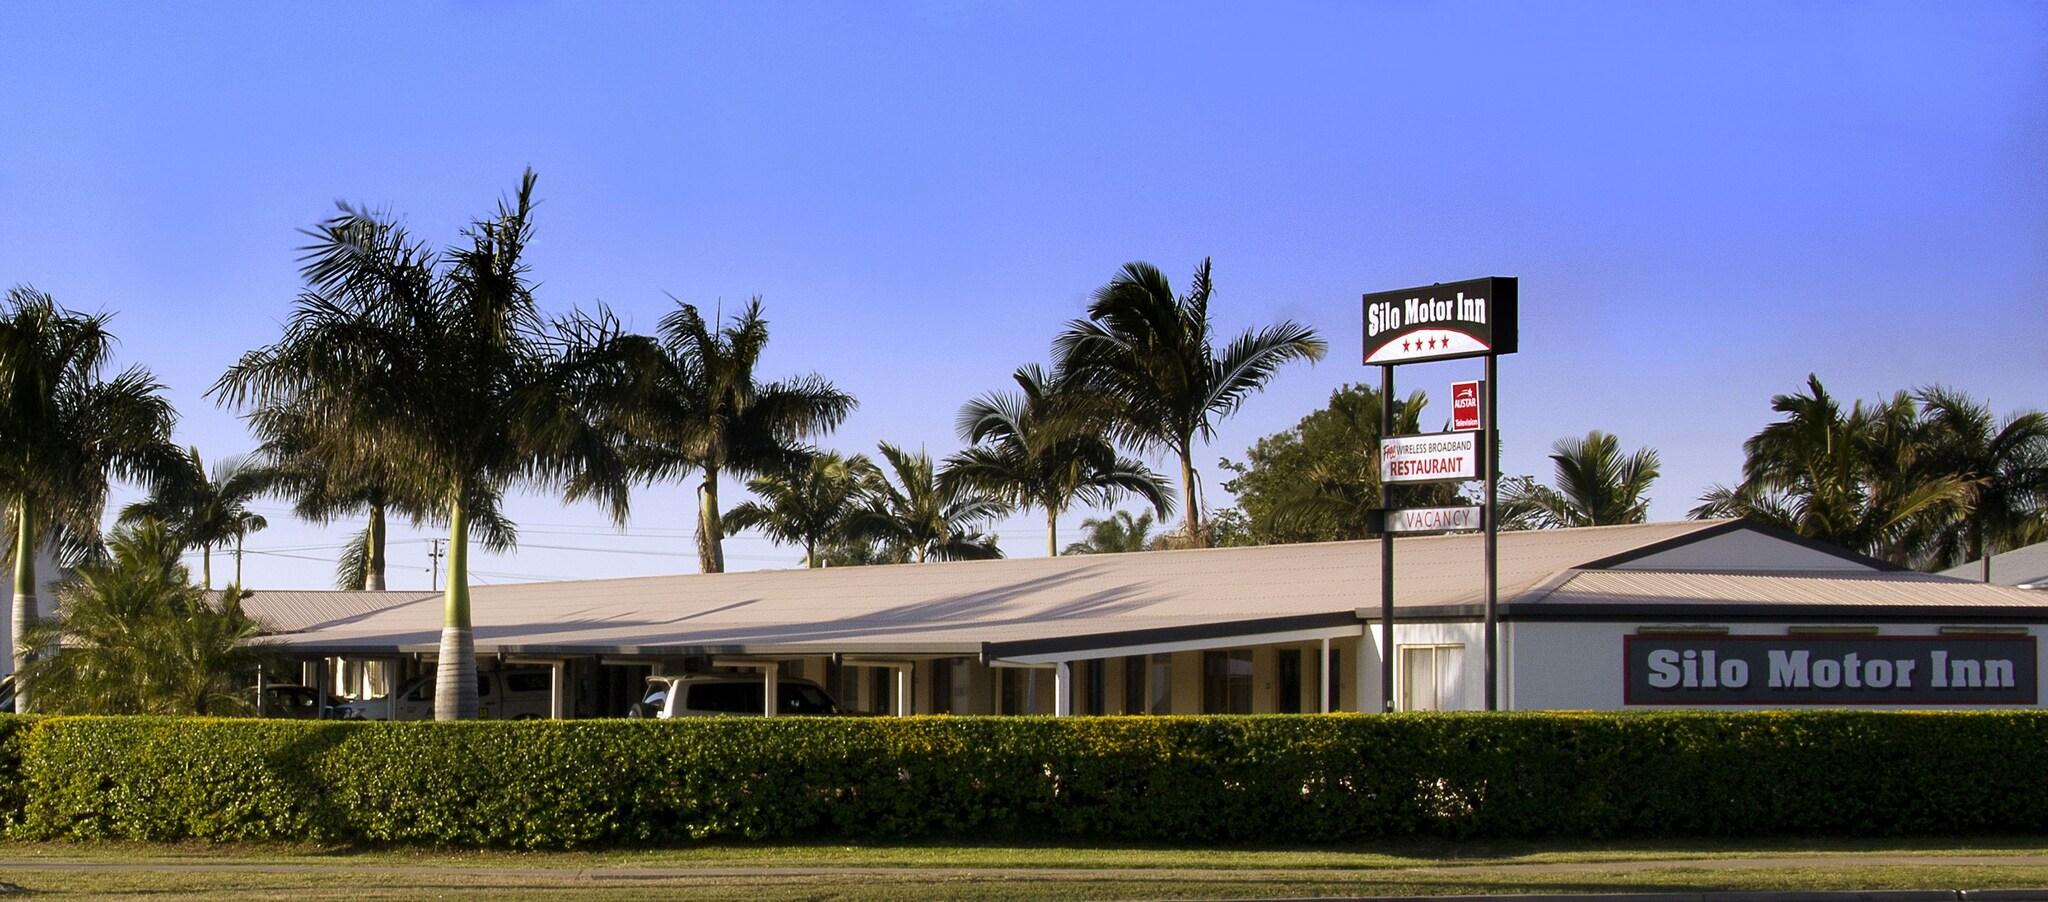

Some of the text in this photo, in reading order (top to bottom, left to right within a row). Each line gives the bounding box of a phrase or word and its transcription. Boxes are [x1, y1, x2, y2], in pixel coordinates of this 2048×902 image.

[1368, 292, 1486, 337] Silo Motor Inn
[1454, 398, 1477, 408] AUSTAR
[1396, 444, 1427, 455] WIRELESS
[1428, 440, 1472, 453] BROADBAND
[1390, 457, 1463, 476] RESTAURANT
[1406, 510, 1470, 528] VACANCY
[1647, 649, 2015, 688] Silo Motor Inn
